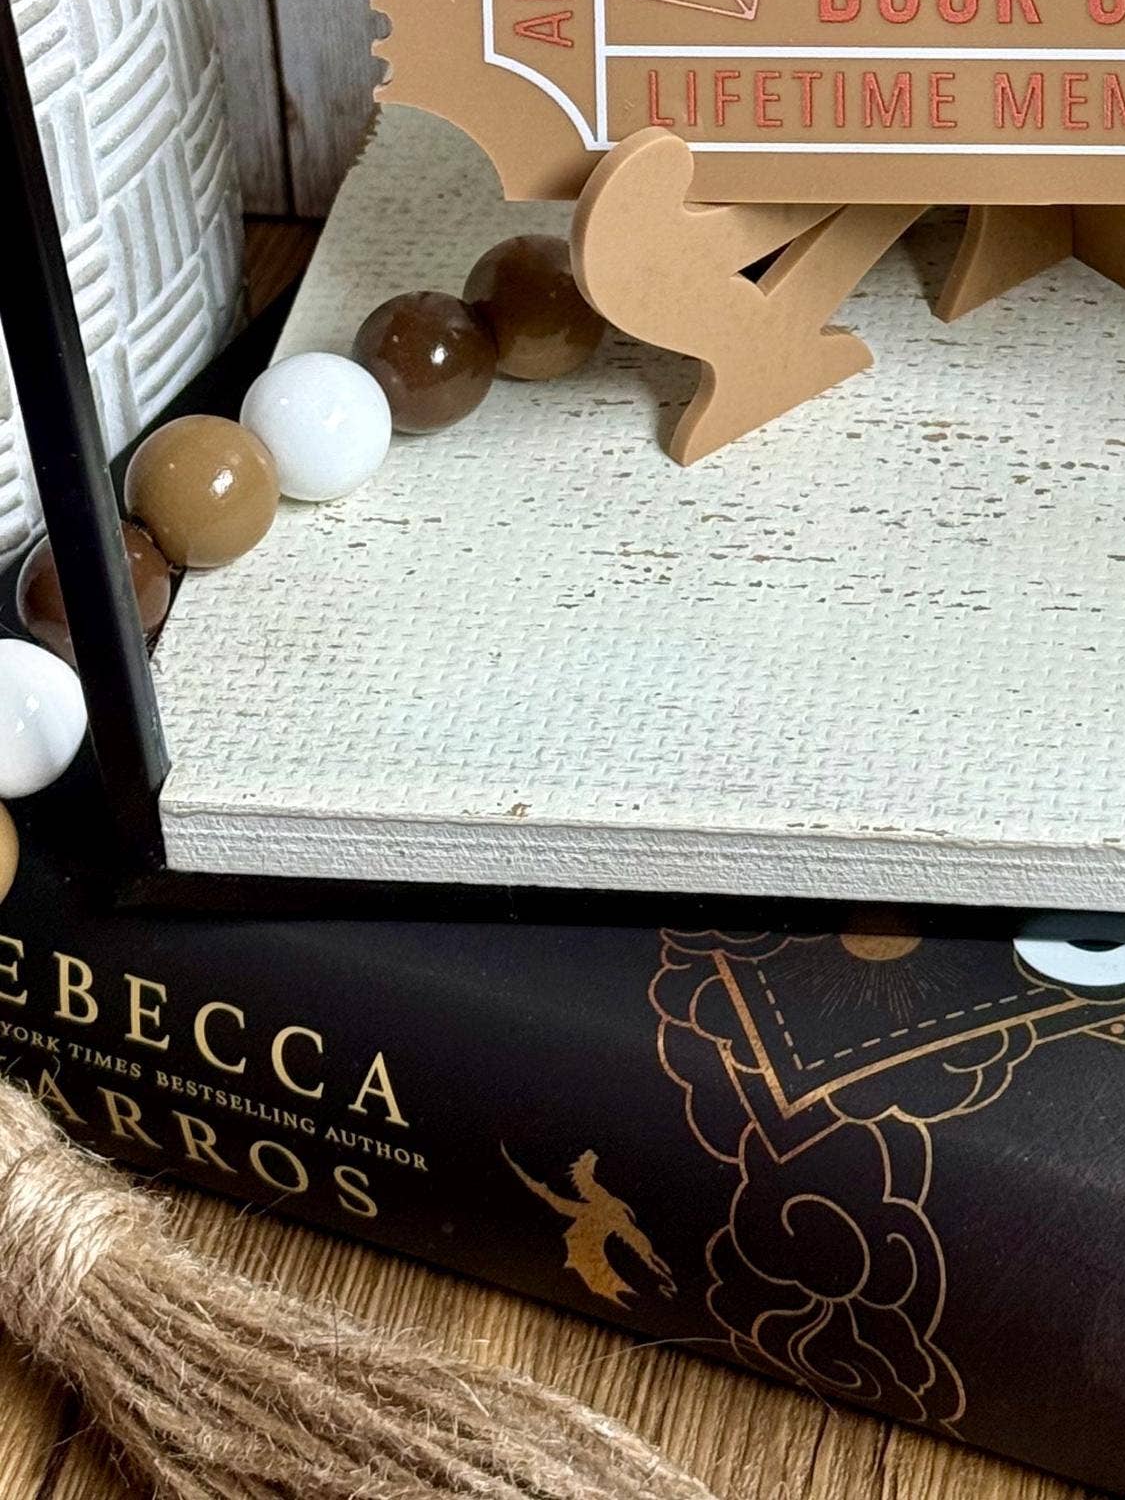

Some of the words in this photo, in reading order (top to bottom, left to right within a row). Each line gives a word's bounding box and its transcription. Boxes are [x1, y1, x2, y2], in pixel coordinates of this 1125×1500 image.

[646, 69, 957, 130] LIFETIME
[0, 934, 409, 1128] EBECCA
[0, 1020, 61, 1054] YORK
[67, 1042, 142, 1079] TIMES
[155, 1070, 316, 1135] BESTSELLING
[325, 1126, 429, 1173] AUTHOR
[28, 1064, 379, 1219] ARROS
